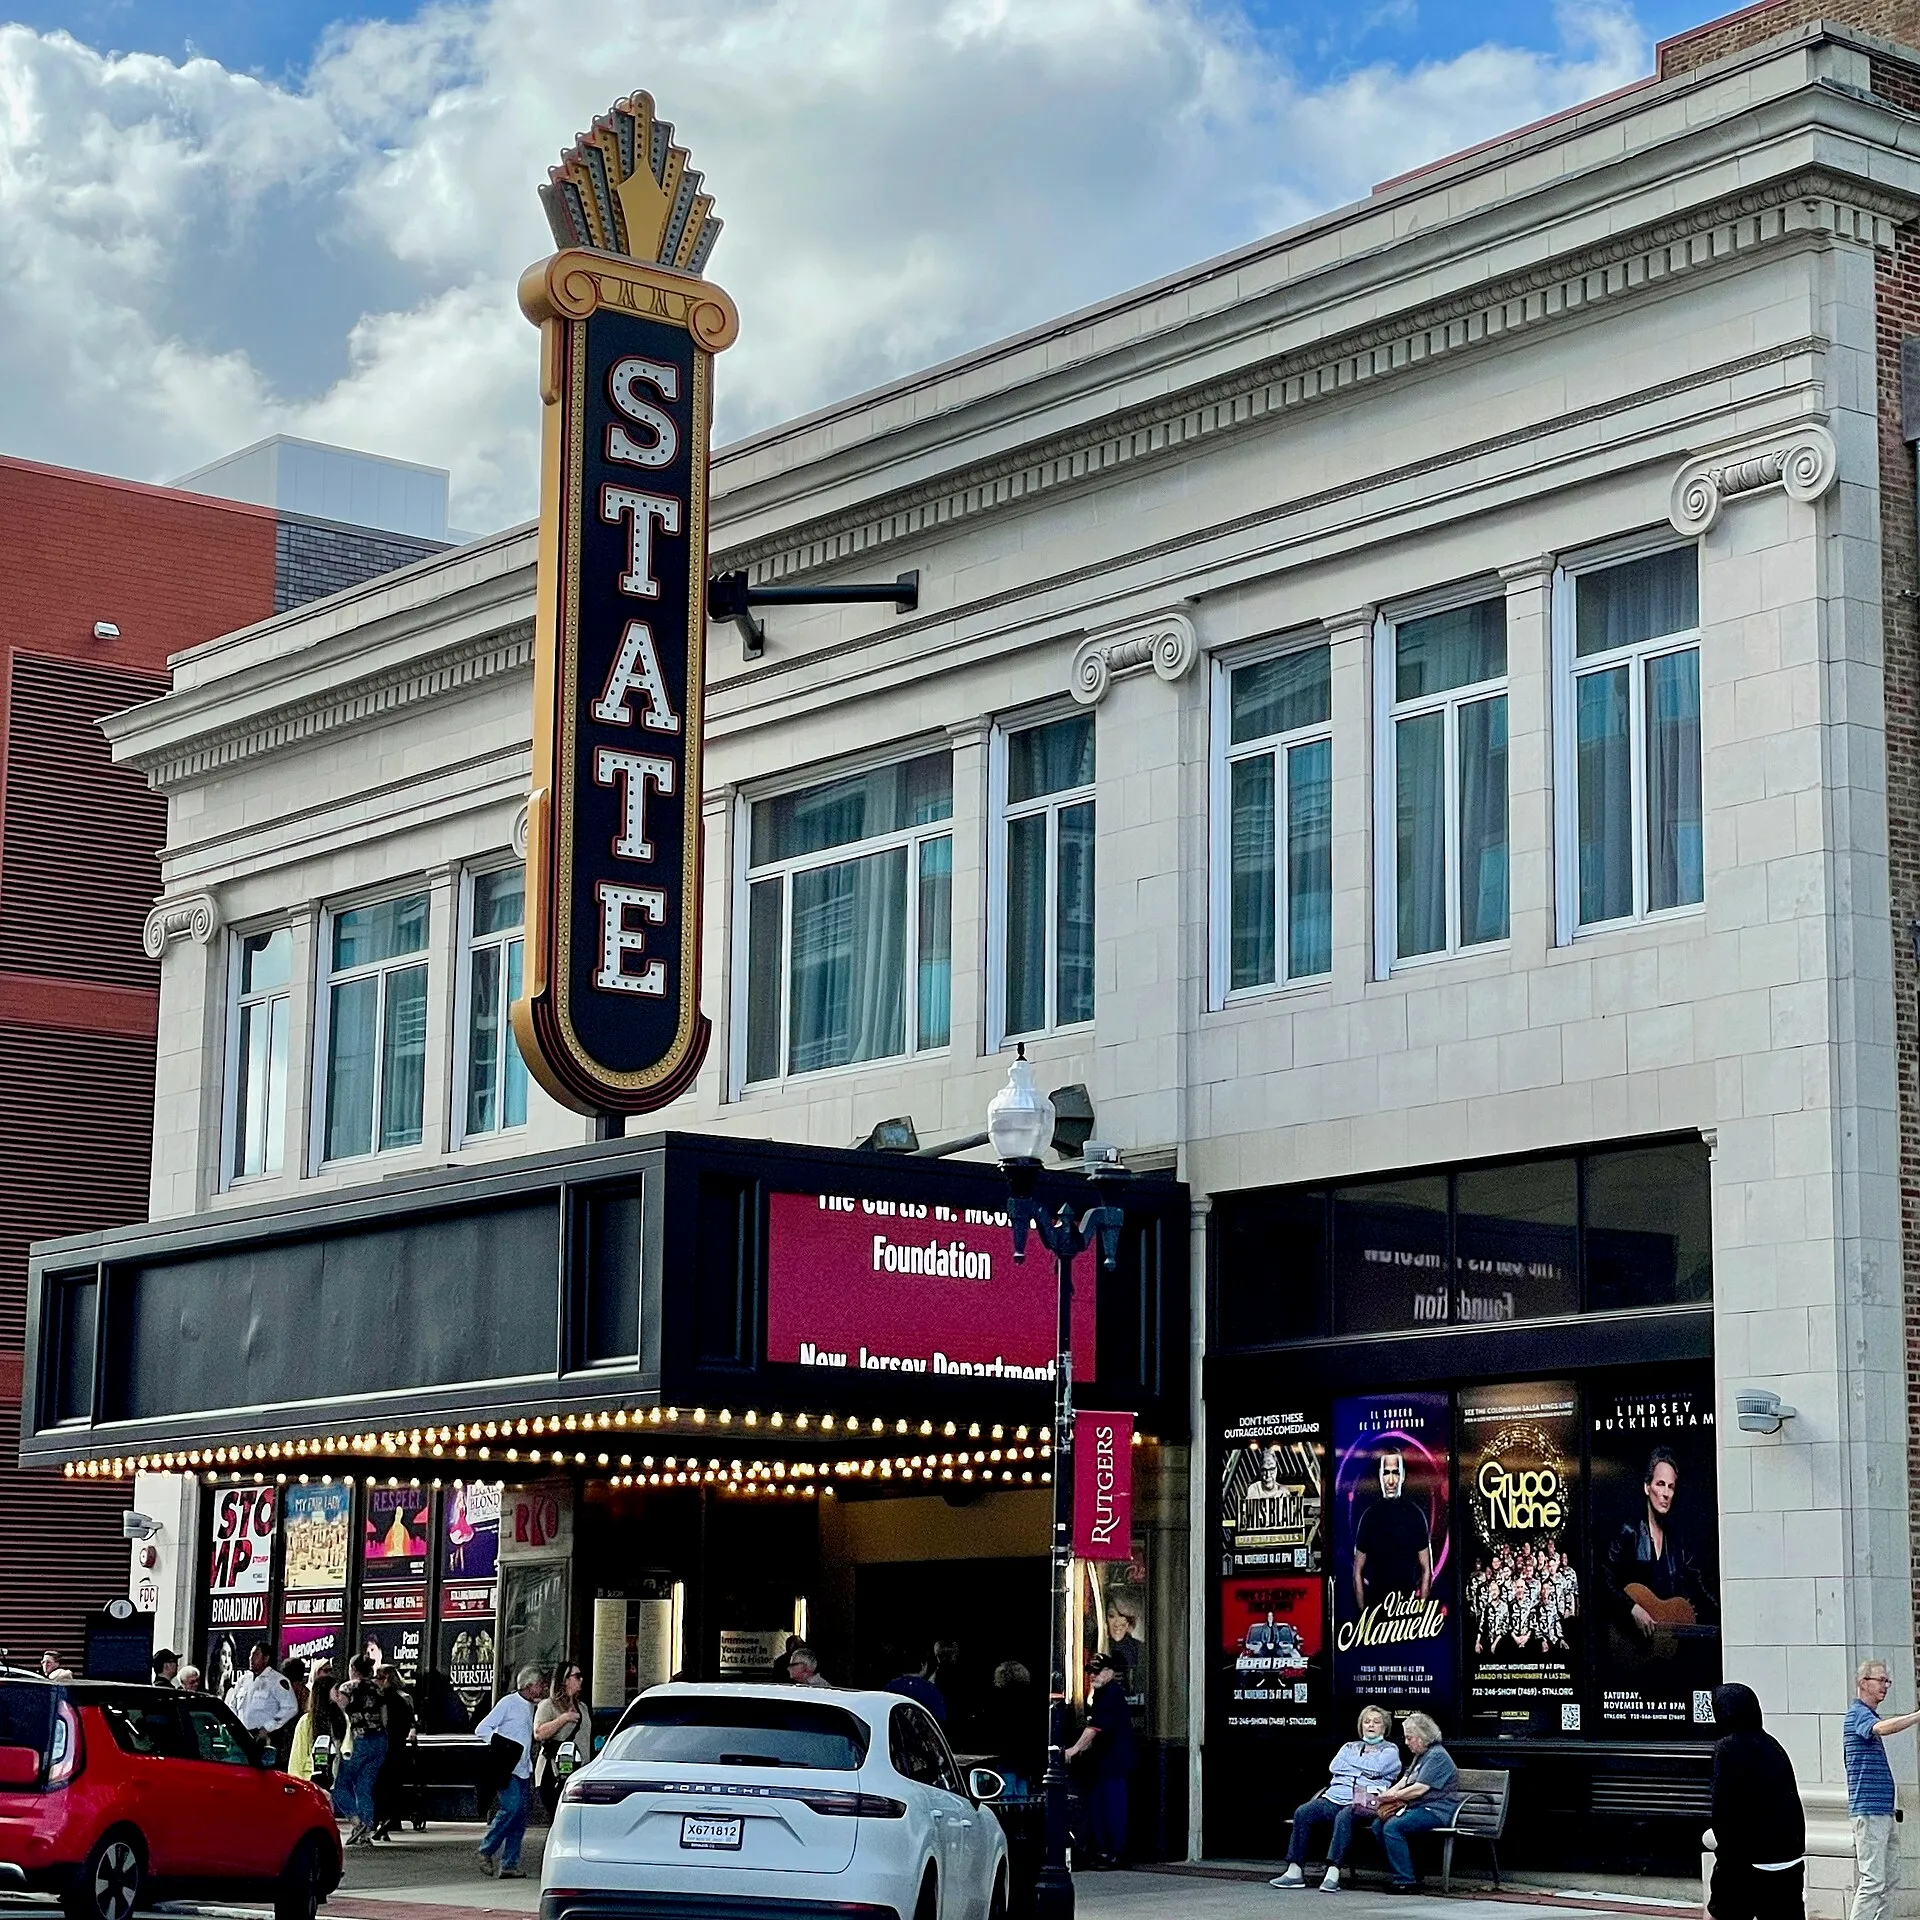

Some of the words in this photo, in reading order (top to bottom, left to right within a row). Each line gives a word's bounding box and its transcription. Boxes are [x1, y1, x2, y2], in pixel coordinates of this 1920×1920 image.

[594, 357, 680, 997] STATE
[872, 1235, 991, 1280] Foundation
[1522, 1404, 1540, 1412] SALSA
[1617, 1401, 1691, 1417] LINDSEY
[1239, 1416, 1262, 1427] DON'T
[1263, 1414, 1280, 1425] MISS
[1280, 1412, 1304, 1424] THESE
[1595, 1413, 1714, 1431] BUCKINGHAM
[1224, 1426, 1273, 1439] OUTRAGEOUS
[1273, 1422, 1320, 1436] COMEDIANS!
[1091, 1426, 1120, 1544] RUTGERS
[1268, 1494, 1304, 1527] BLACK
[1490, 1490, 1562, 1530] Niche
[515, 1495, 559, 1546] RKO
[140, 1588, 155, 1602] FDC
[1383, 1590, 1427, 1618] Victor
[1337, 1599, 1445, 1652] Manuelle
[289, 1634, 334, 1659] Menopause
[394, 1646, 418, 1659] LuPone
[721, 1645, 757, 1655] Yourself
[721, 1655, 739, 1664] Arts
[1272, 1656, 1309, 1669] RAGE
[1472, 1688, 1517, 1696] 732-246-SHOW
[1603, 1701, 1644, 1710] NOVEMBER
[1657, 1701, 1667, 1710] AT
[664, 1784, 770, 1796] PORSCHE
[687, 1824, 737, 1836] X671812
